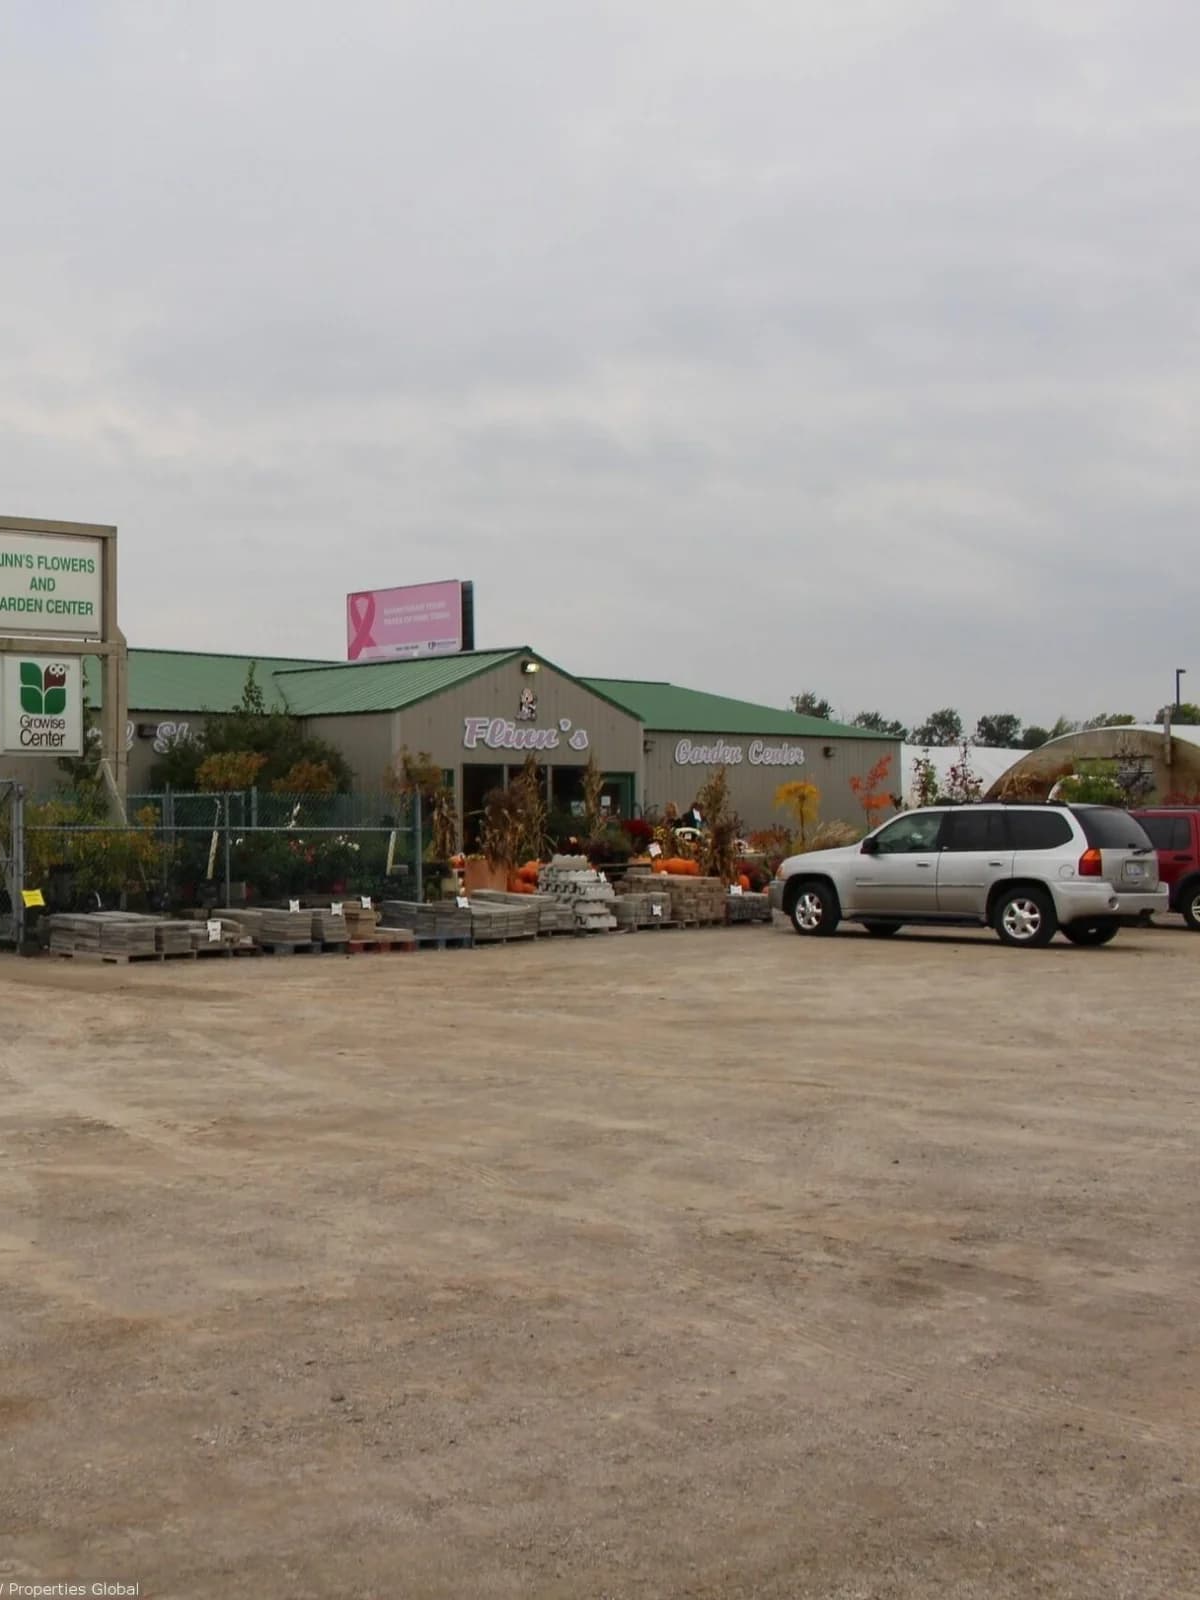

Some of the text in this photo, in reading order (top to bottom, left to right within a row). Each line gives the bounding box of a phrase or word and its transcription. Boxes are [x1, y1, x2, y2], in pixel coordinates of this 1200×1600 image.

[37, 555, 95, 574] FLOWERS
[29, 577, 56, 592] AND
[46, 600, 94, 616] CENTER
[20, 714, 65, 729] Growise
[20, 728, 65, 747] Center
[464, 718, 588, 750] Flinn's
[675, 738, 805, 765] Garden Center
